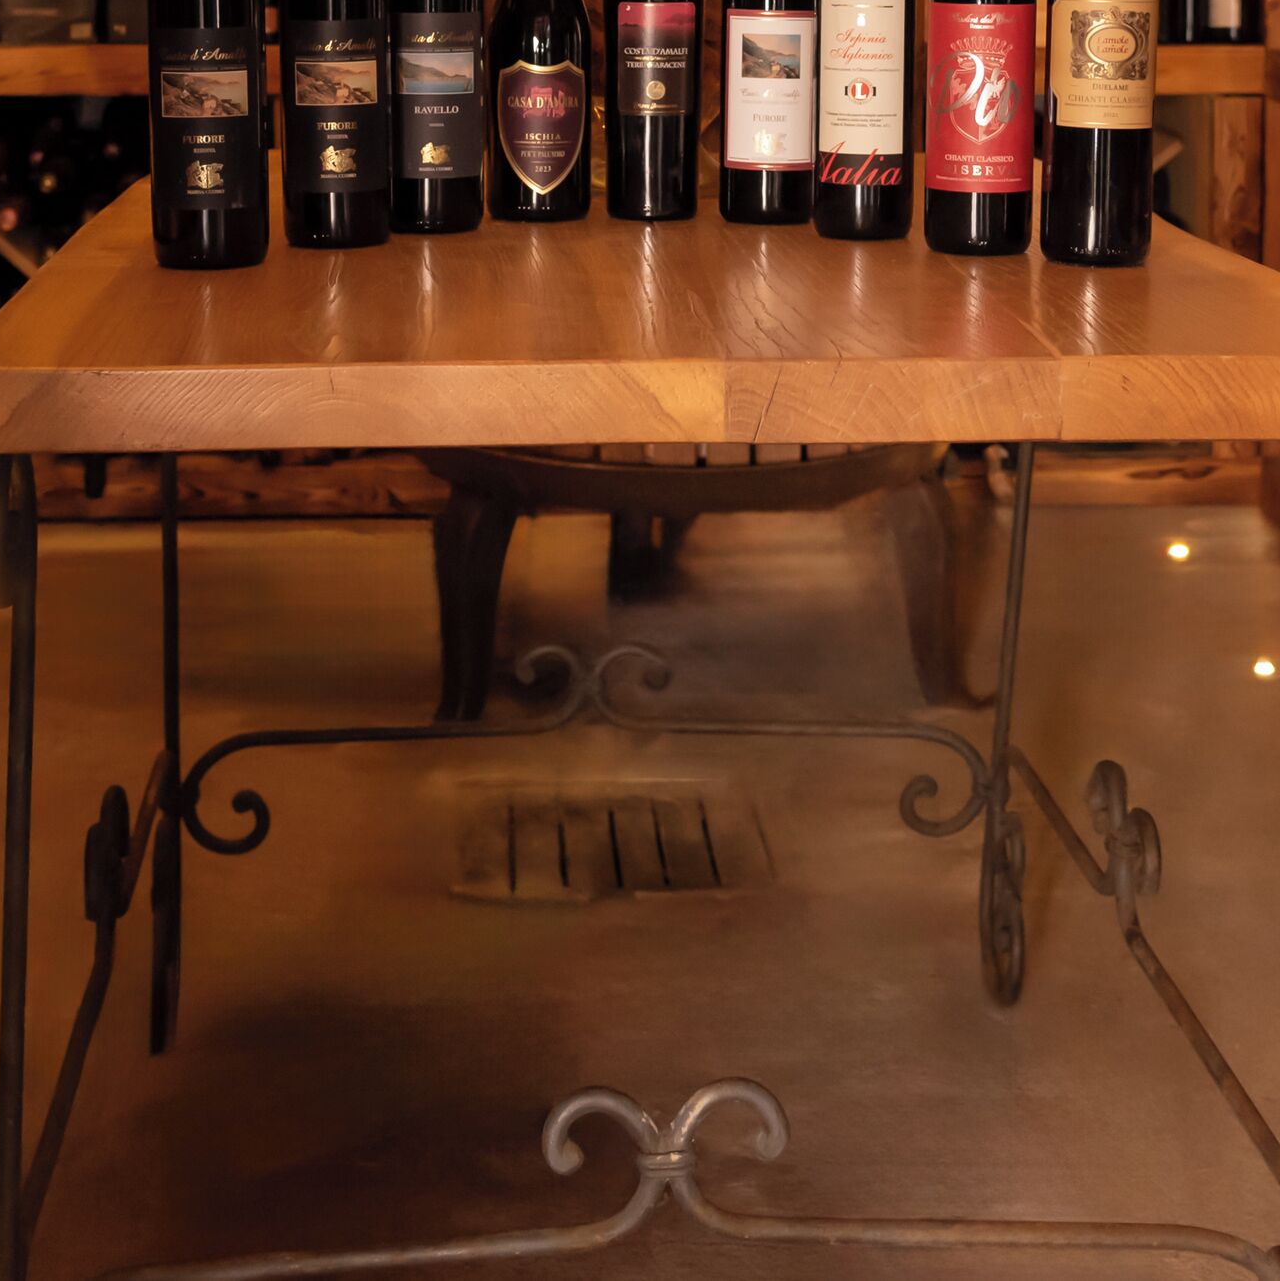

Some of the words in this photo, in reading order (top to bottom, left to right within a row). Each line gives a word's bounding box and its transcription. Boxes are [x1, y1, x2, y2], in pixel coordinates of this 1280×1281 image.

[836, 29, 887, 47] Irpinia
[830, 46, 894, 65] Aglianico
[855, 82, 867, 100] L
[508, 97, 532, 108] CASA
[1068, 94, 1107, 103] CHIANTI
[414, 106, 459, 115] RAVELLO
[753, 113, 787, 123] FURORE
[317, 122, 358, 131] FURORE
[182, 135, 225, 144] FURORE
[945, 154, 974, 162] CHIANTI
[976, 155, 1014, 163] CLASSICO
